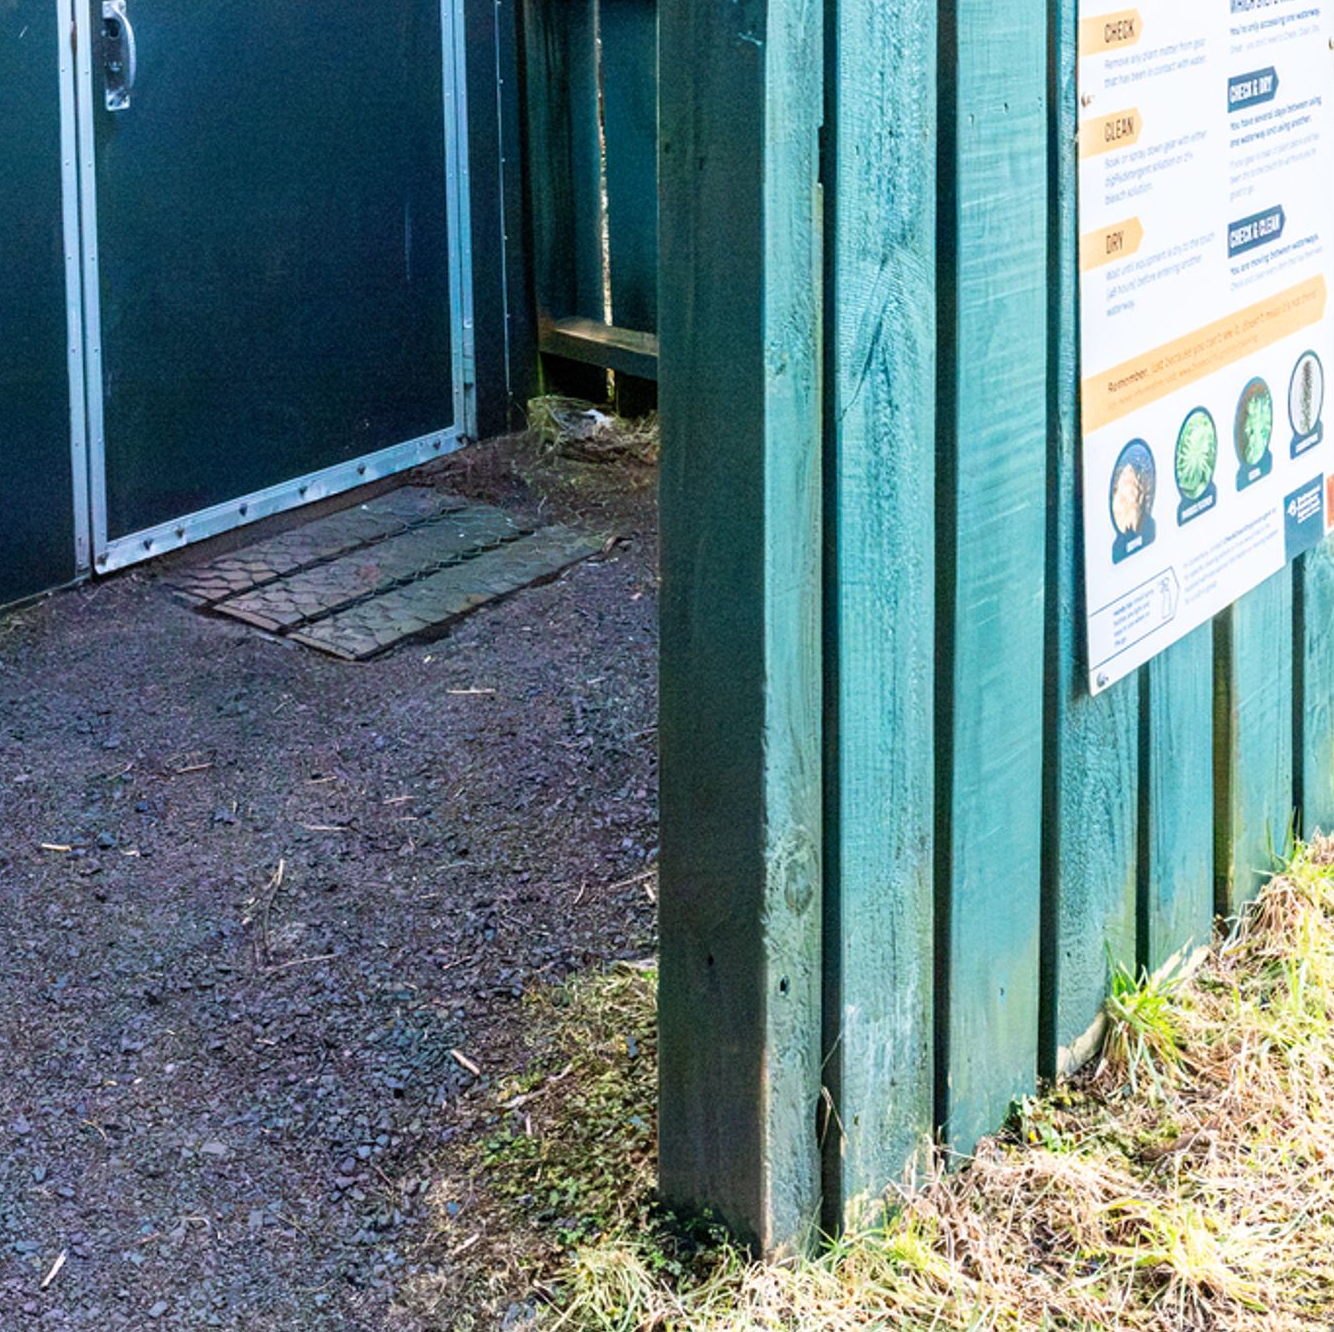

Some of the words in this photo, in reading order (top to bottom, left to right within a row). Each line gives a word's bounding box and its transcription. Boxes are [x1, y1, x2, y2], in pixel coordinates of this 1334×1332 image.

[1104, 18, 1135, 43] CHECK
[1104, 116, 1135, 143] CLEAN
[1106, 230, 1125, 254] DRY
